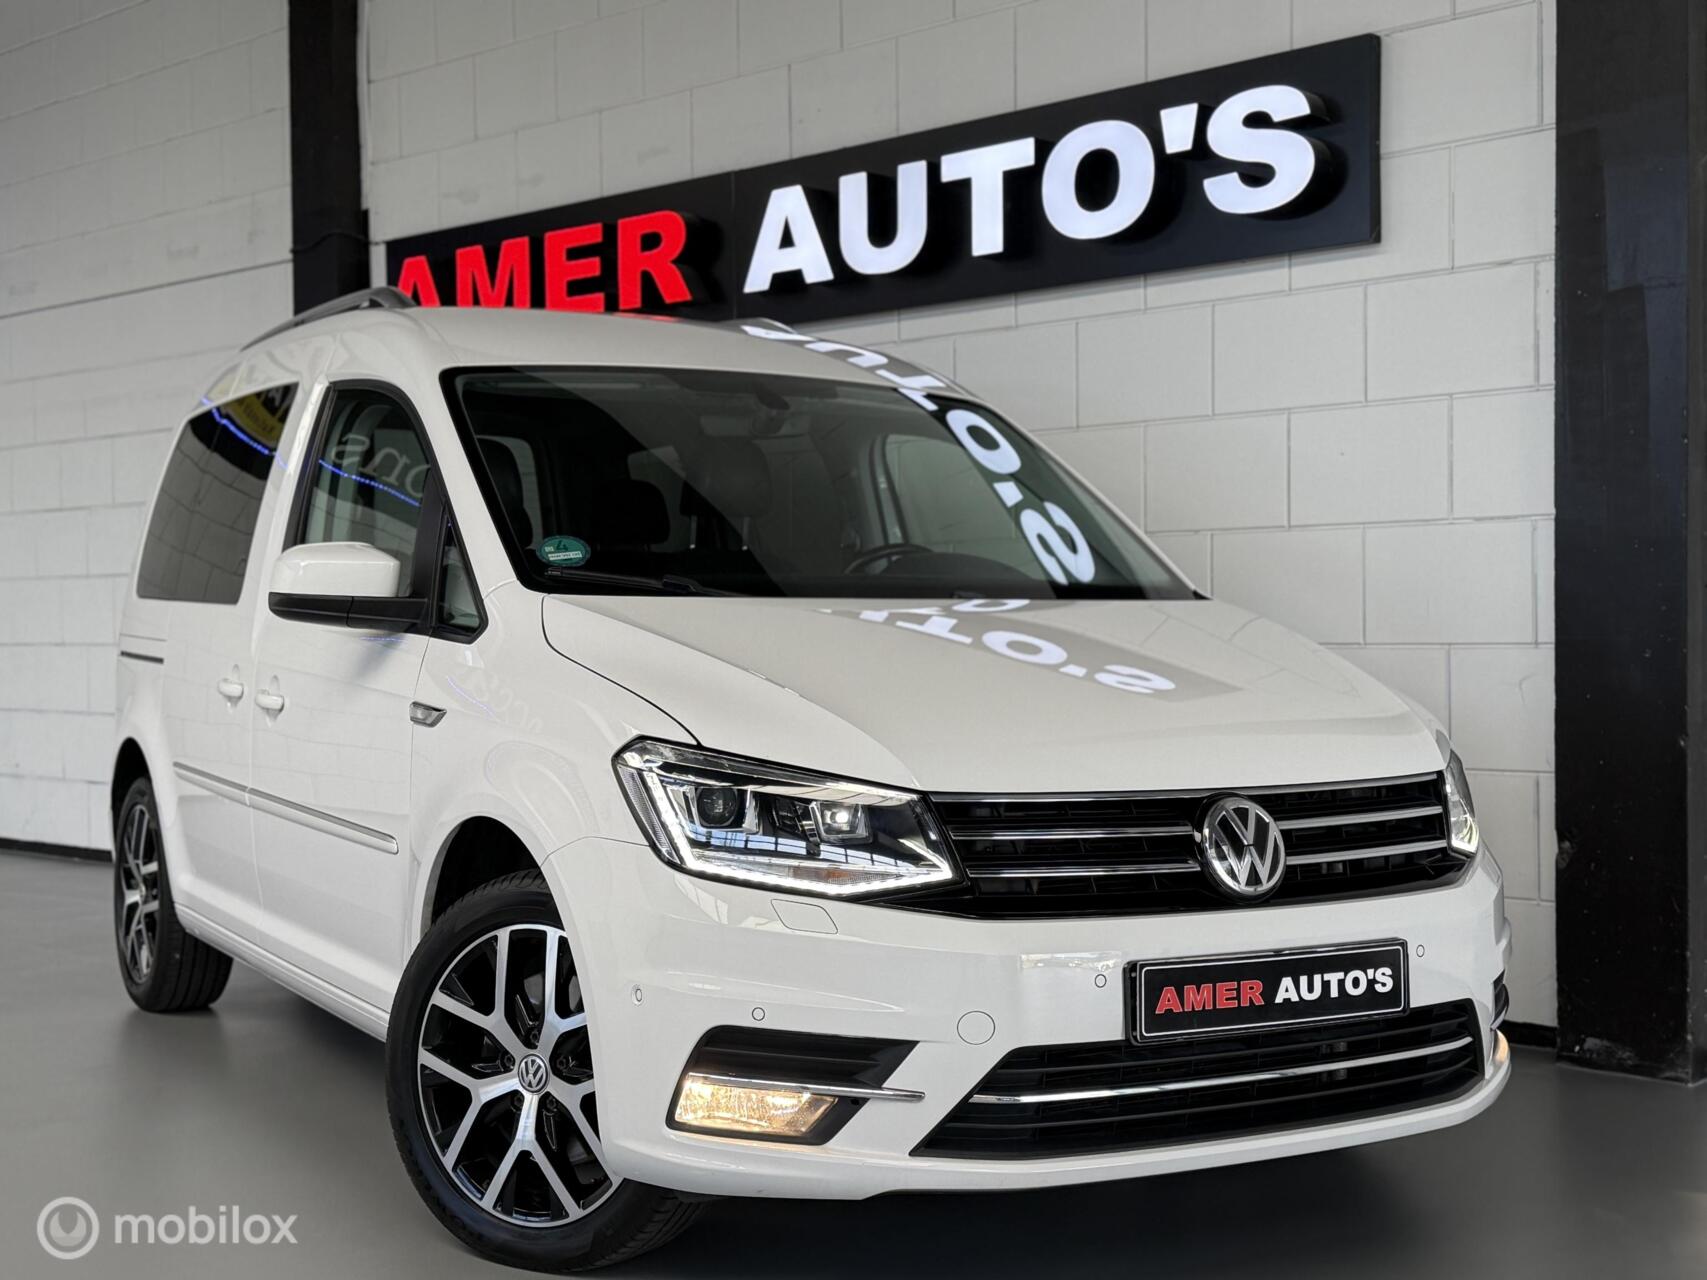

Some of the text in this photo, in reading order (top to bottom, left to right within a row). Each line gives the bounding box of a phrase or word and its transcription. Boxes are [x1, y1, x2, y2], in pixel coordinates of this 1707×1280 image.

[397, 84, 1316, 313] AMER AUTO'S
[1155, 966, 1394, 1015] AMER AUTO'S
